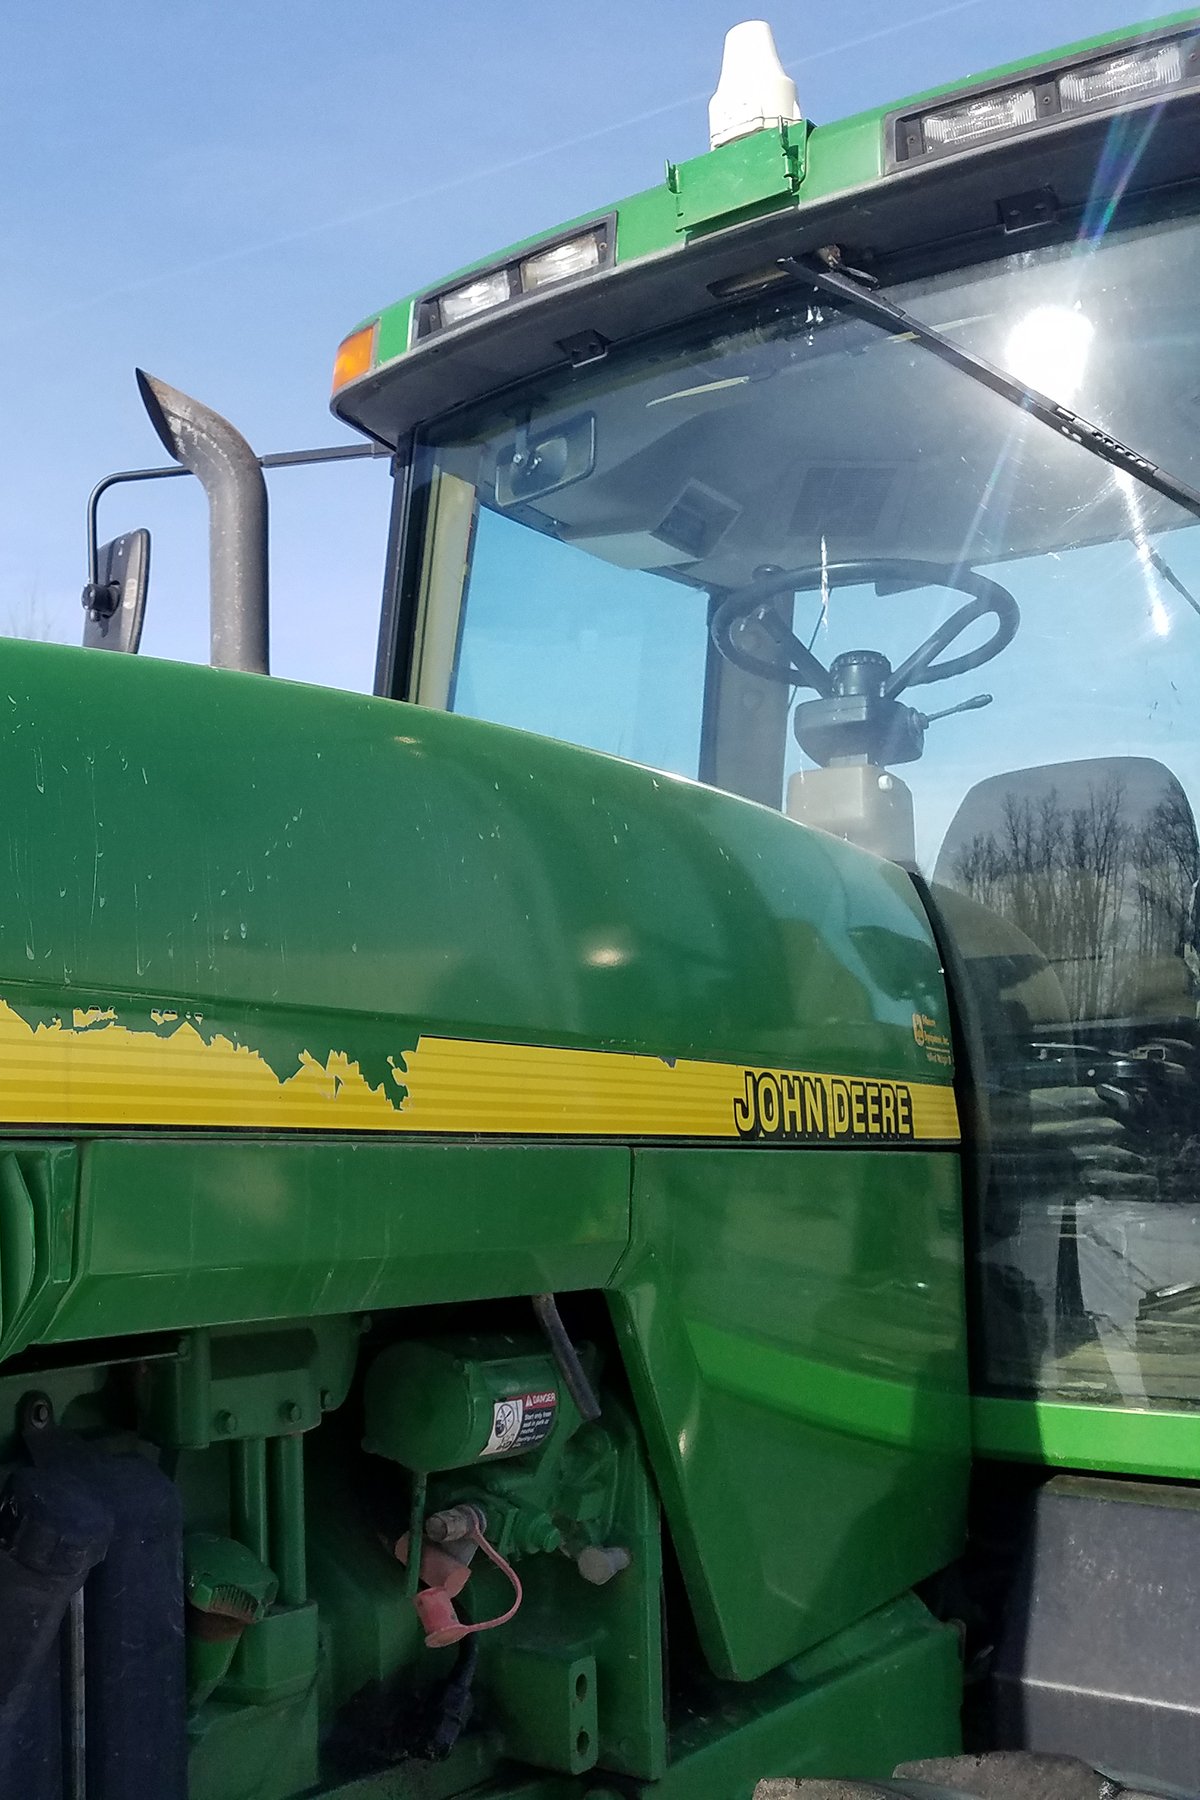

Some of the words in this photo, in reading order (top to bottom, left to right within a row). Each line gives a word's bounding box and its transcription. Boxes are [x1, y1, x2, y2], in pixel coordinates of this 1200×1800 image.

[734, 1073, 825, 1133] JOHN
[832, 1081, 911, 1135] DEERE
[532, 1392, 556, 1404] DANGER
